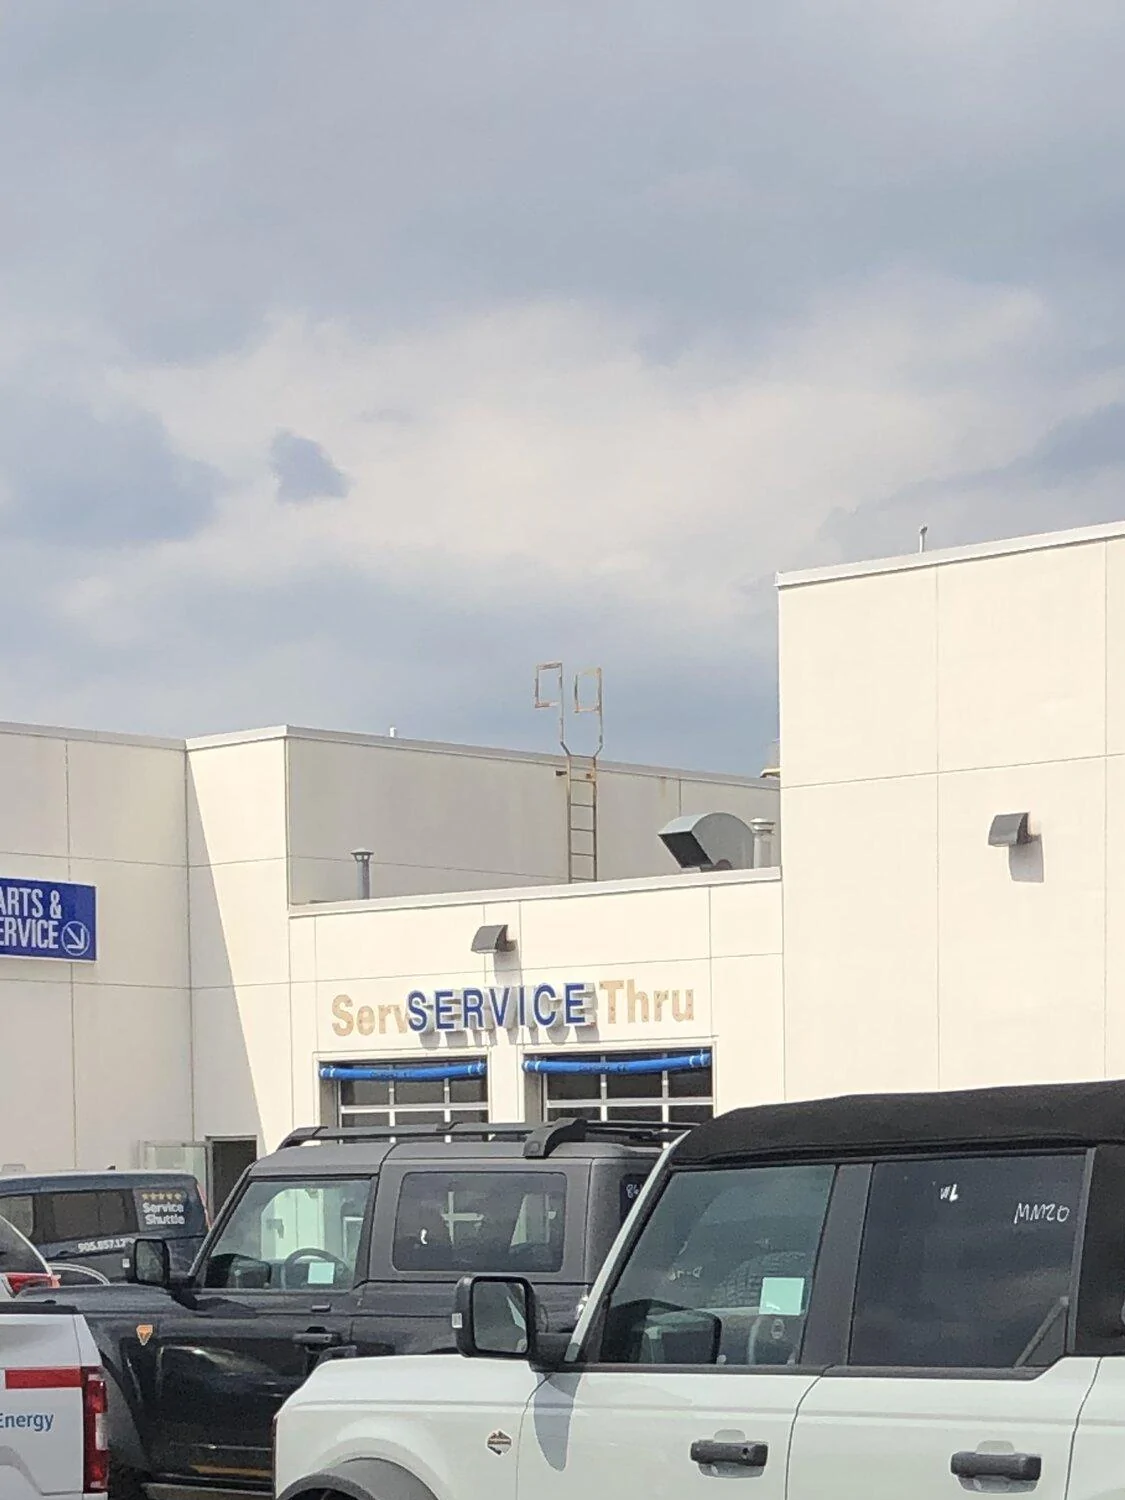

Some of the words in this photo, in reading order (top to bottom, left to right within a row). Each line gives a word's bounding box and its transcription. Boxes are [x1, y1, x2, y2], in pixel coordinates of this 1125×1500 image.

[50, 890, 62, 919] &
[408, 983, 587, 1032] SERVICE
[599, 979, 695, 1025] Thru
[142, 1202, 184, 1213] Service
[145, 1214, 186, 1225] Shuttle
